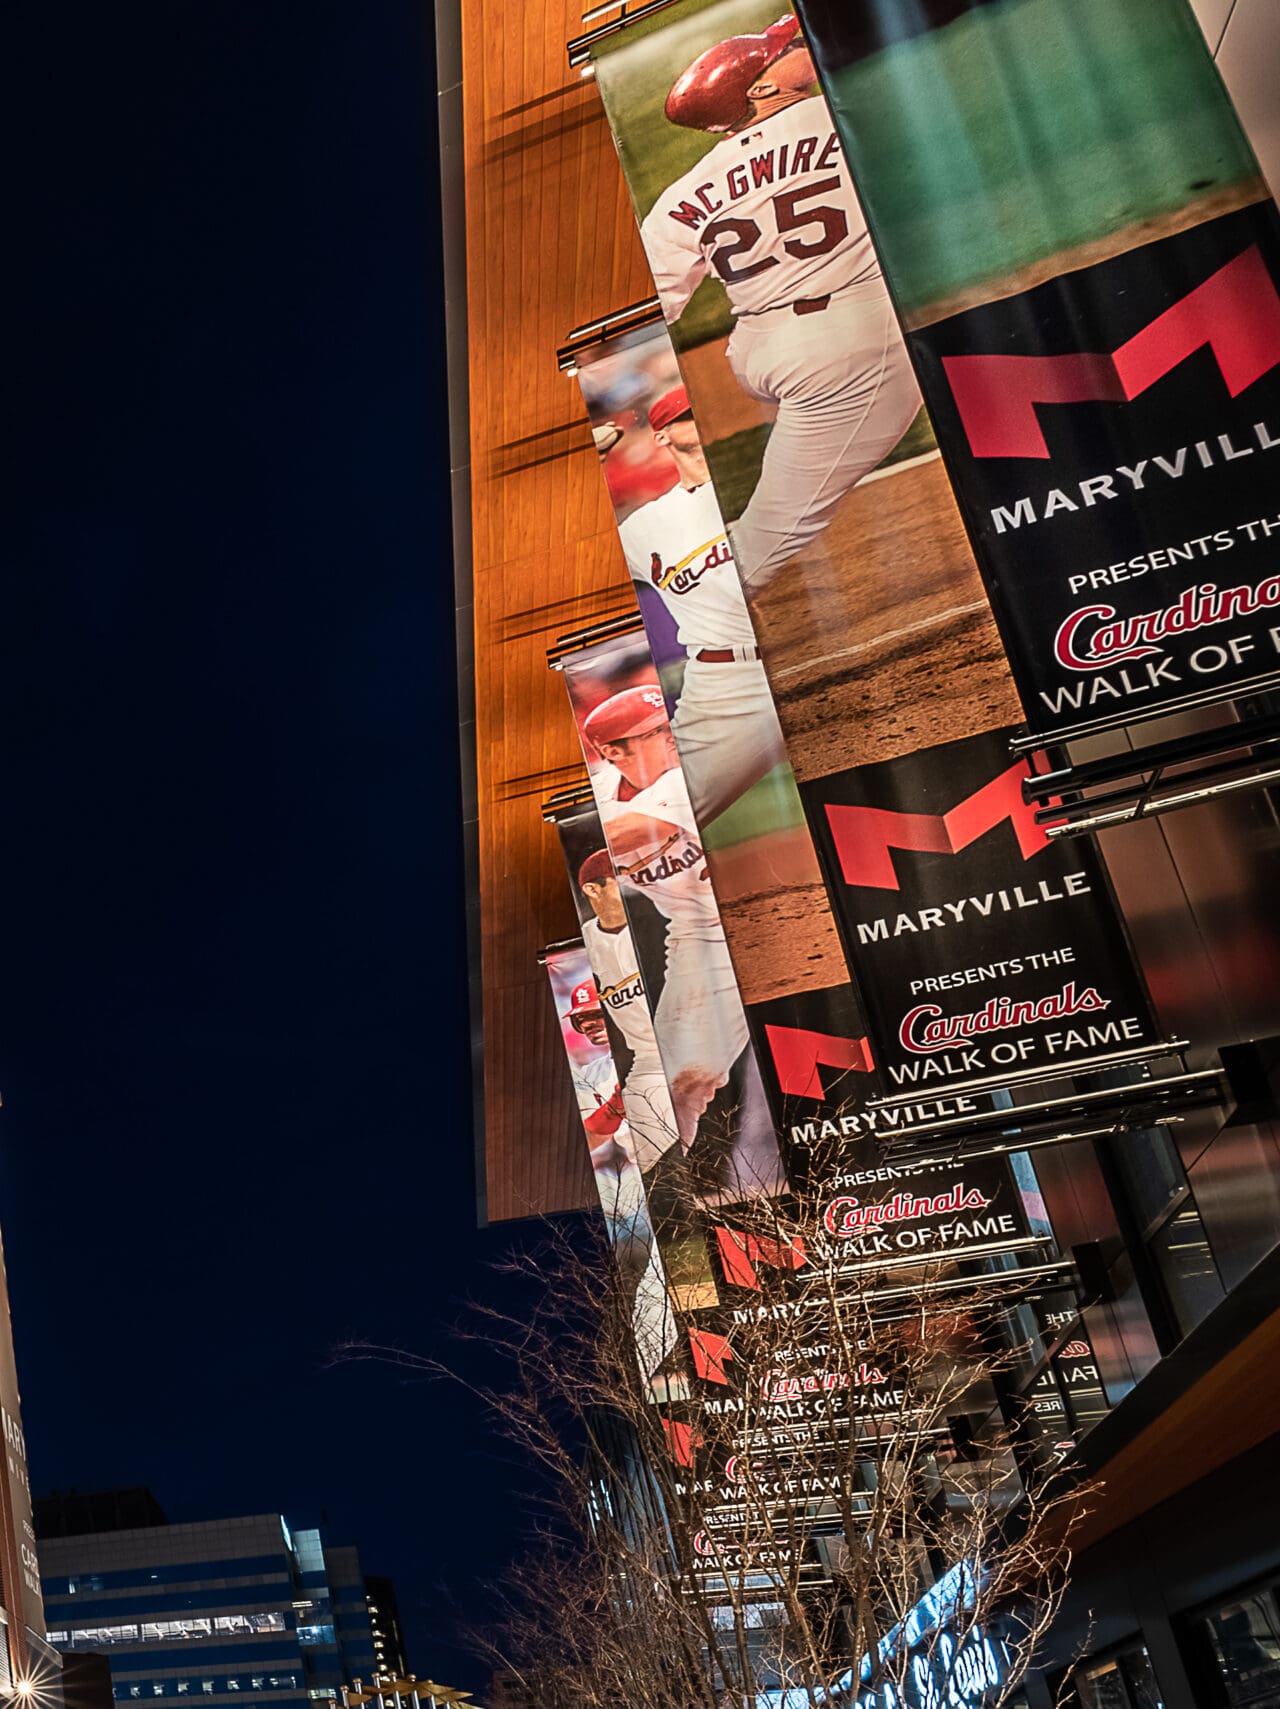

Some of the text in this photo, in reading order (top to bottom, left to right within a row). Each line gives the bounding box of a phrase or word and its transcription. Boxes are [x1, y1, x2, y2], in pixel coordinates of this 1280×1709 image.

[700, 175, 849, 286] 25
[1068, 530, 1235, 595] PRESENTS
[1039, 657, 1182, 714] WALK
[1188, 634, 1256, 674] OF
[856, 871, 1092, 945] MARYVILLE
[909, 946, 1076, 996] PRESENTS THE
[888, 1017, 1144, 1086] WALK OF FAME
[898, 981, 1112, 1055] Cardinals
[791, 1095, 977, 1145] MARYVILLE
[818, 1213, 1017, 1260] WALK OF FAME
[823, 1182, 992, 1238] Cardinals
